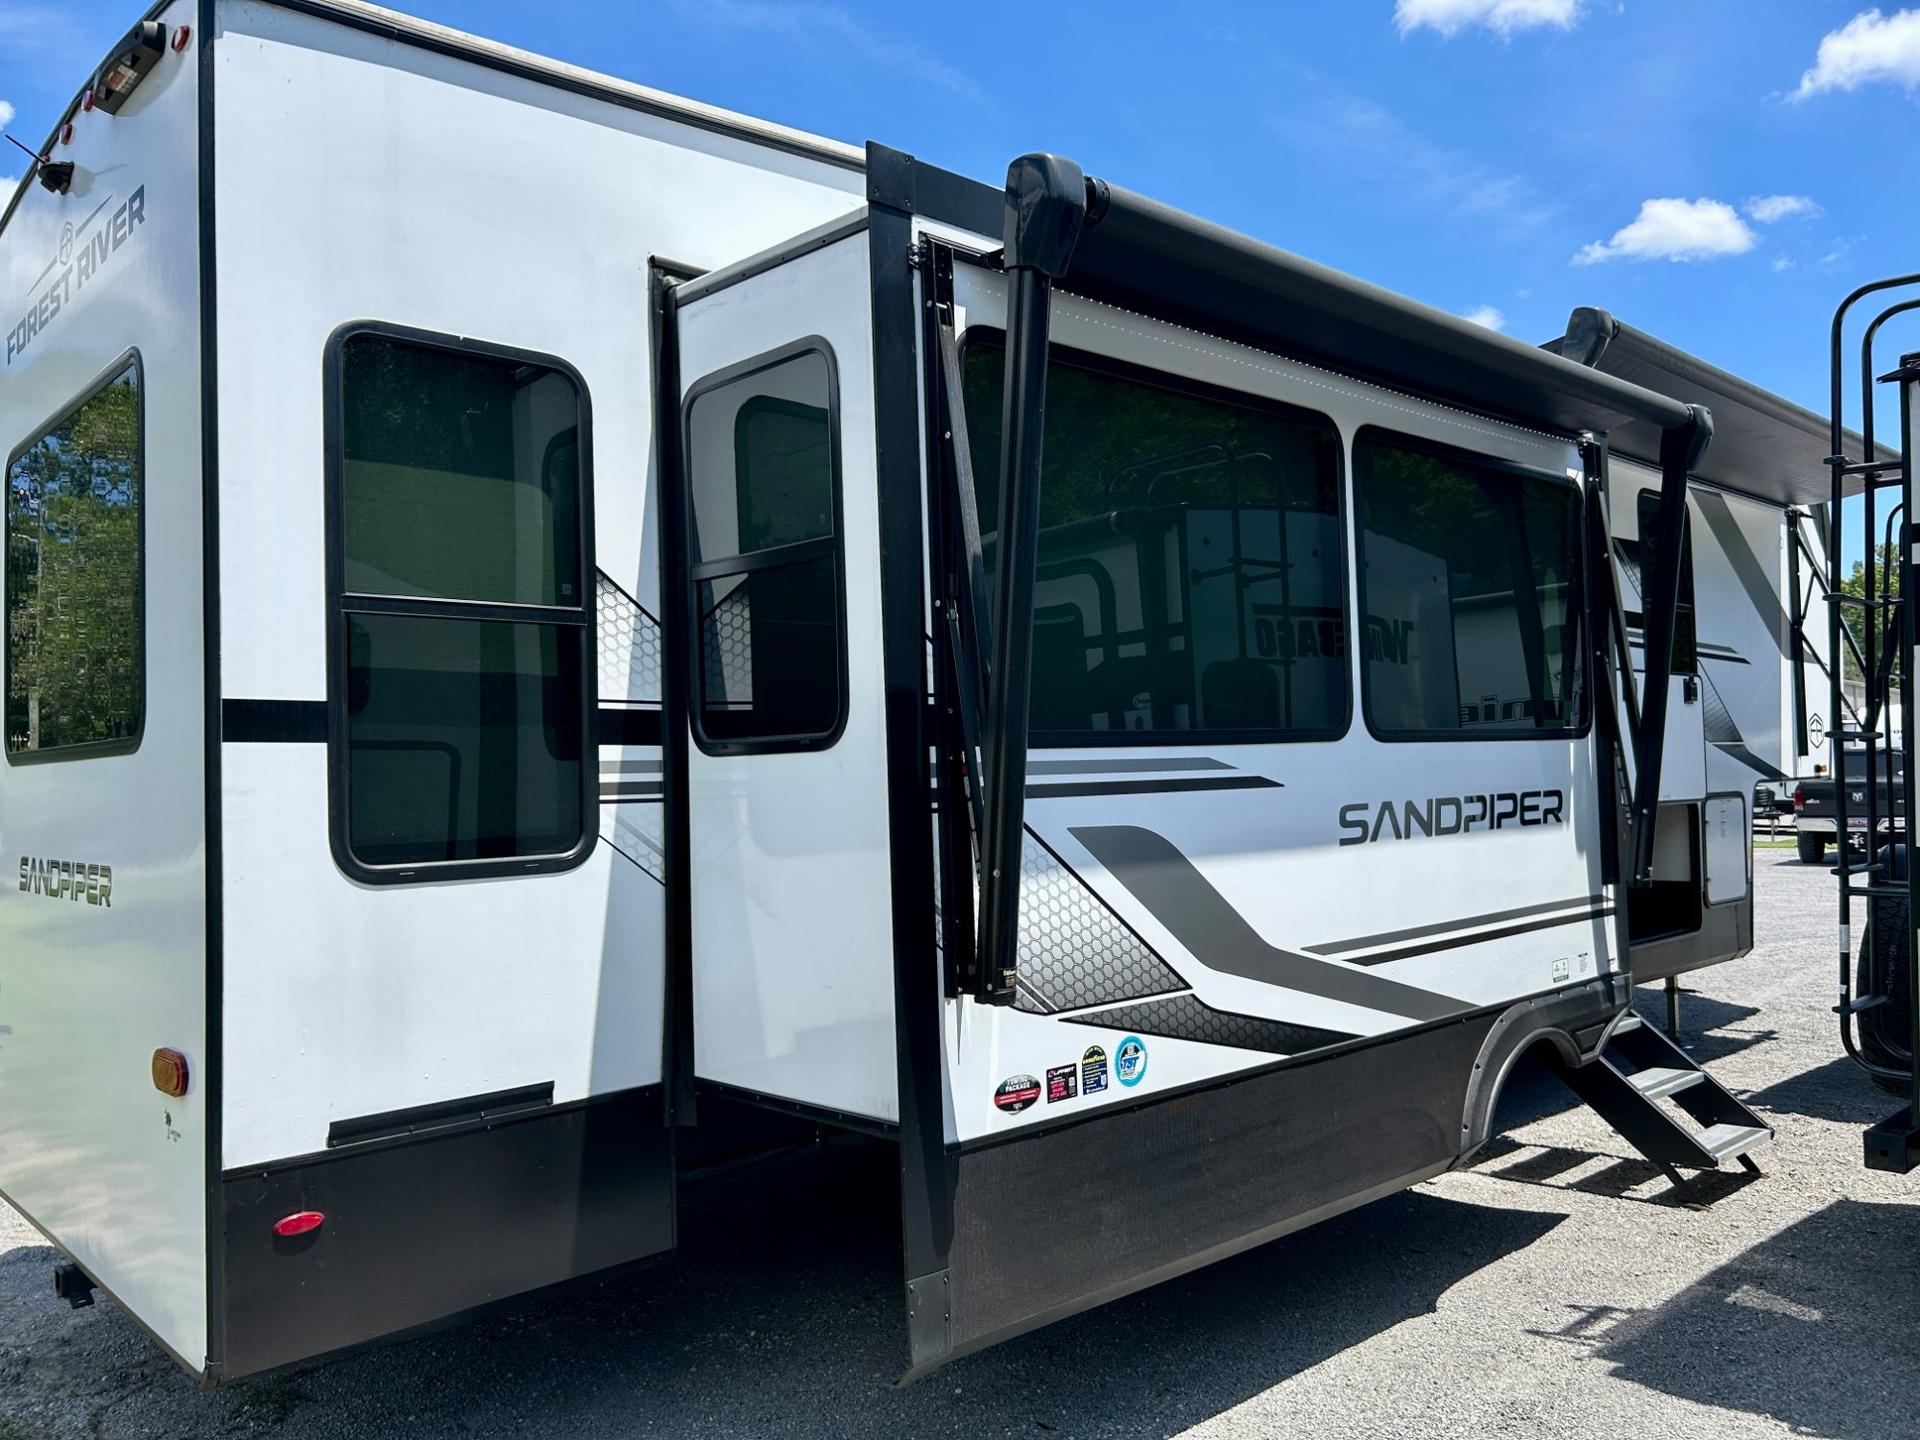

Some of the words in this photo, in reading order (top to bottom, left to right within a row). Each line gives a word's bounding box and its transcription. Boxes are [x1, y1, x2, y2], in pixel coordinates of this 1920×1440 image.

[7, 264, 73, 365] FOREST
[77, 184, 146, 290] RIVER
[1338, 788, 1564, 847] SANDPIPER
[18, 855, 112, 908] SANDPIPER
[1005, 1080, 1031, 1093] PACKAGE
[1121, 1055, 1140, 1070] TST
